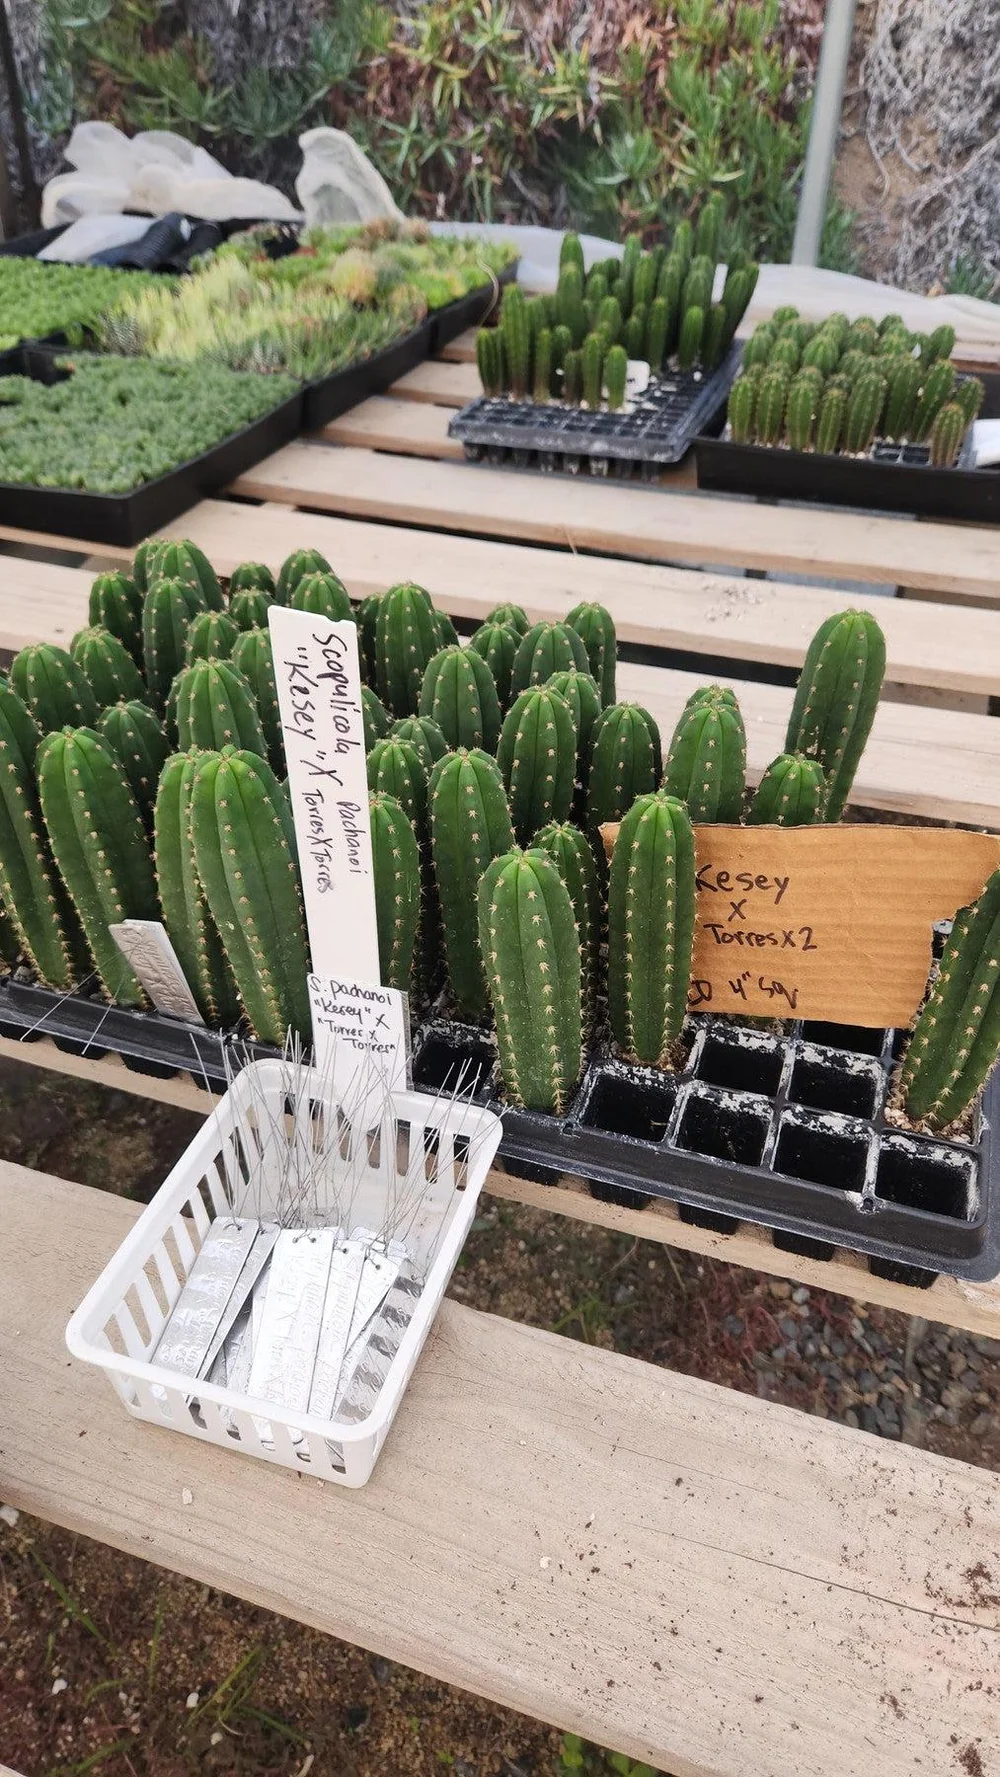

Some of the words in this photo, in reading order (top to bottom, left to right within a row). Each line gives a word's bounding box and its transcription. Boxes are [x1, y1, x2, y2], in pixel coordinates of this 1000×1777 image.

[312, 633, 361, 754] Scopulicola
[336, 800, 368, 874] Pachanoi
[695, 864, 790, 905] Kesey
[310, 975, 327, 993] S.
[330, 979, 392, 1005] Pachanoi
